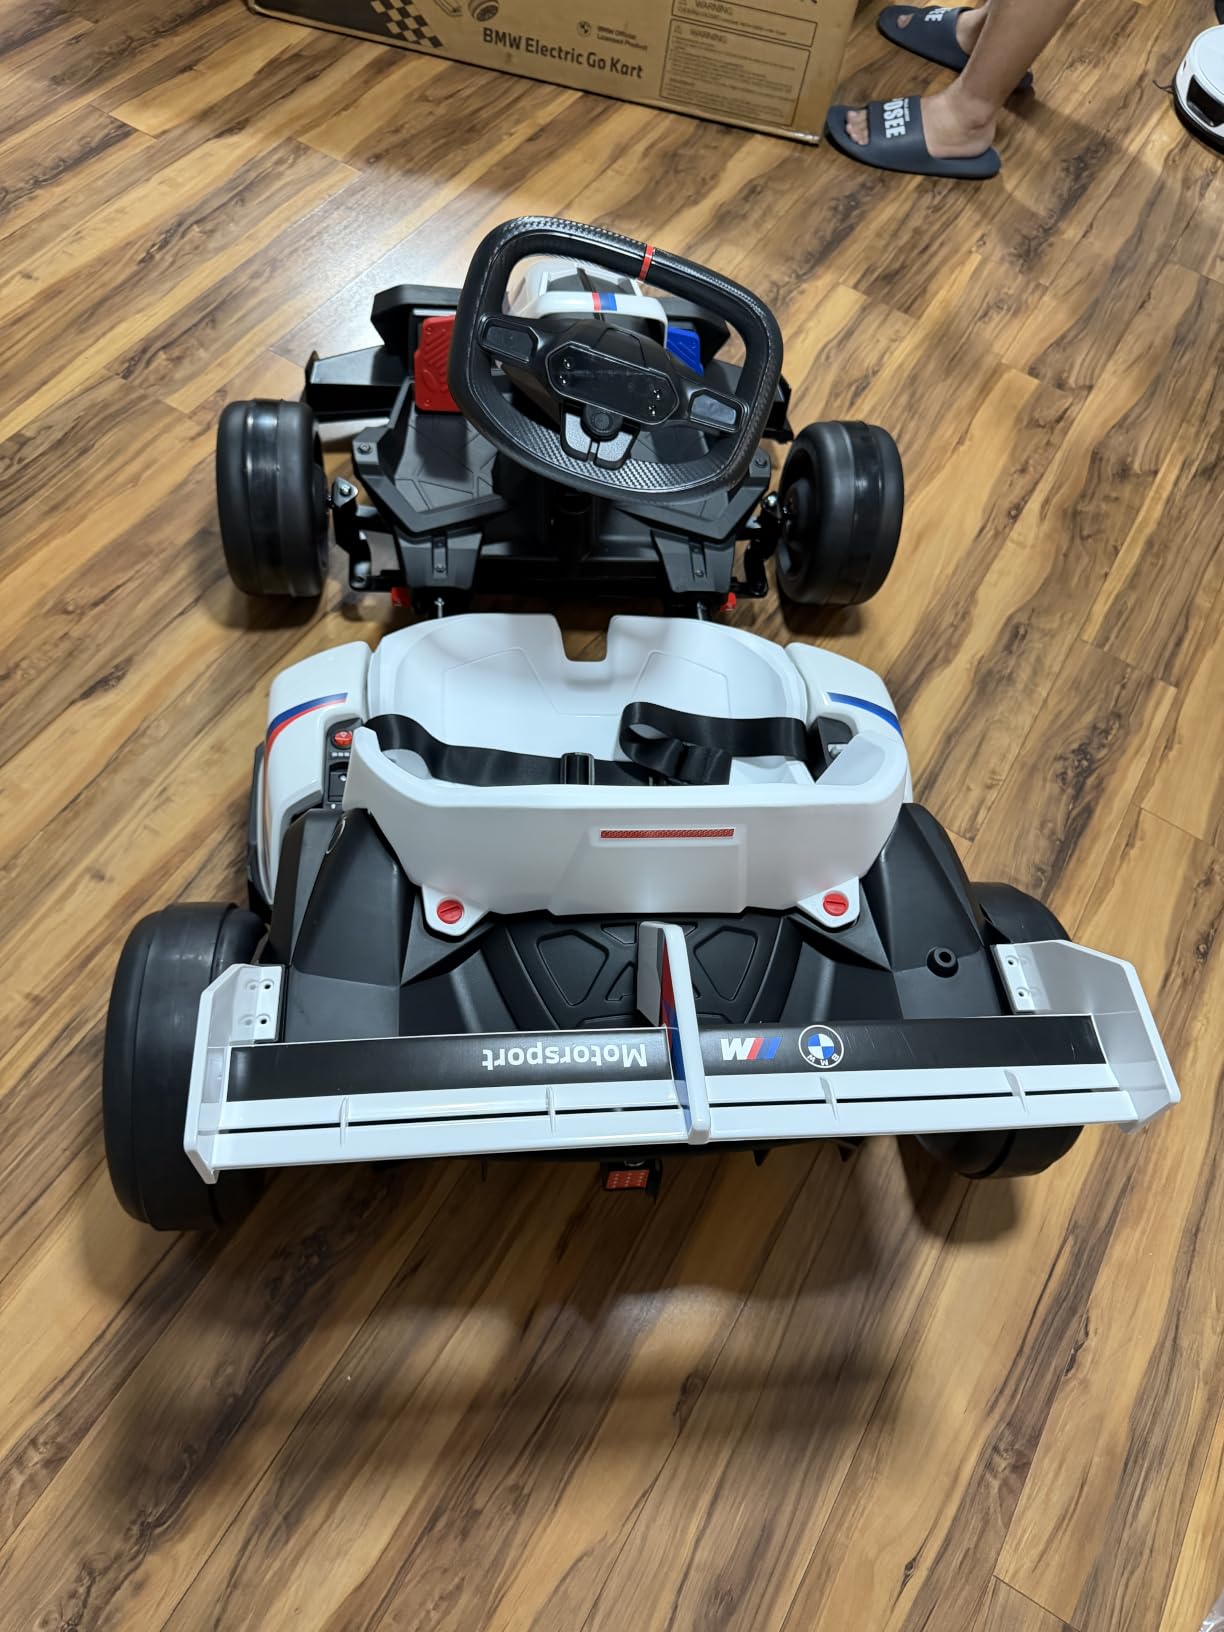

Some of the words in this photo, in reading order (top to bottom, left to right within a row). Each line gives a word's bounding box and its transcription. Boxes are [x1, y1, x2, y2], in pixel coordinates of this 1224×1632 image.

[483, 26, 522, 50] BMW
[525, 37, 583, 65] Electric
[586, 51, 607, 70] Go
[610, 56, 643, 79] Kart
[883, 97, 906, 139] OSEE
[481, 1041, 648, 1071] Motorsport
